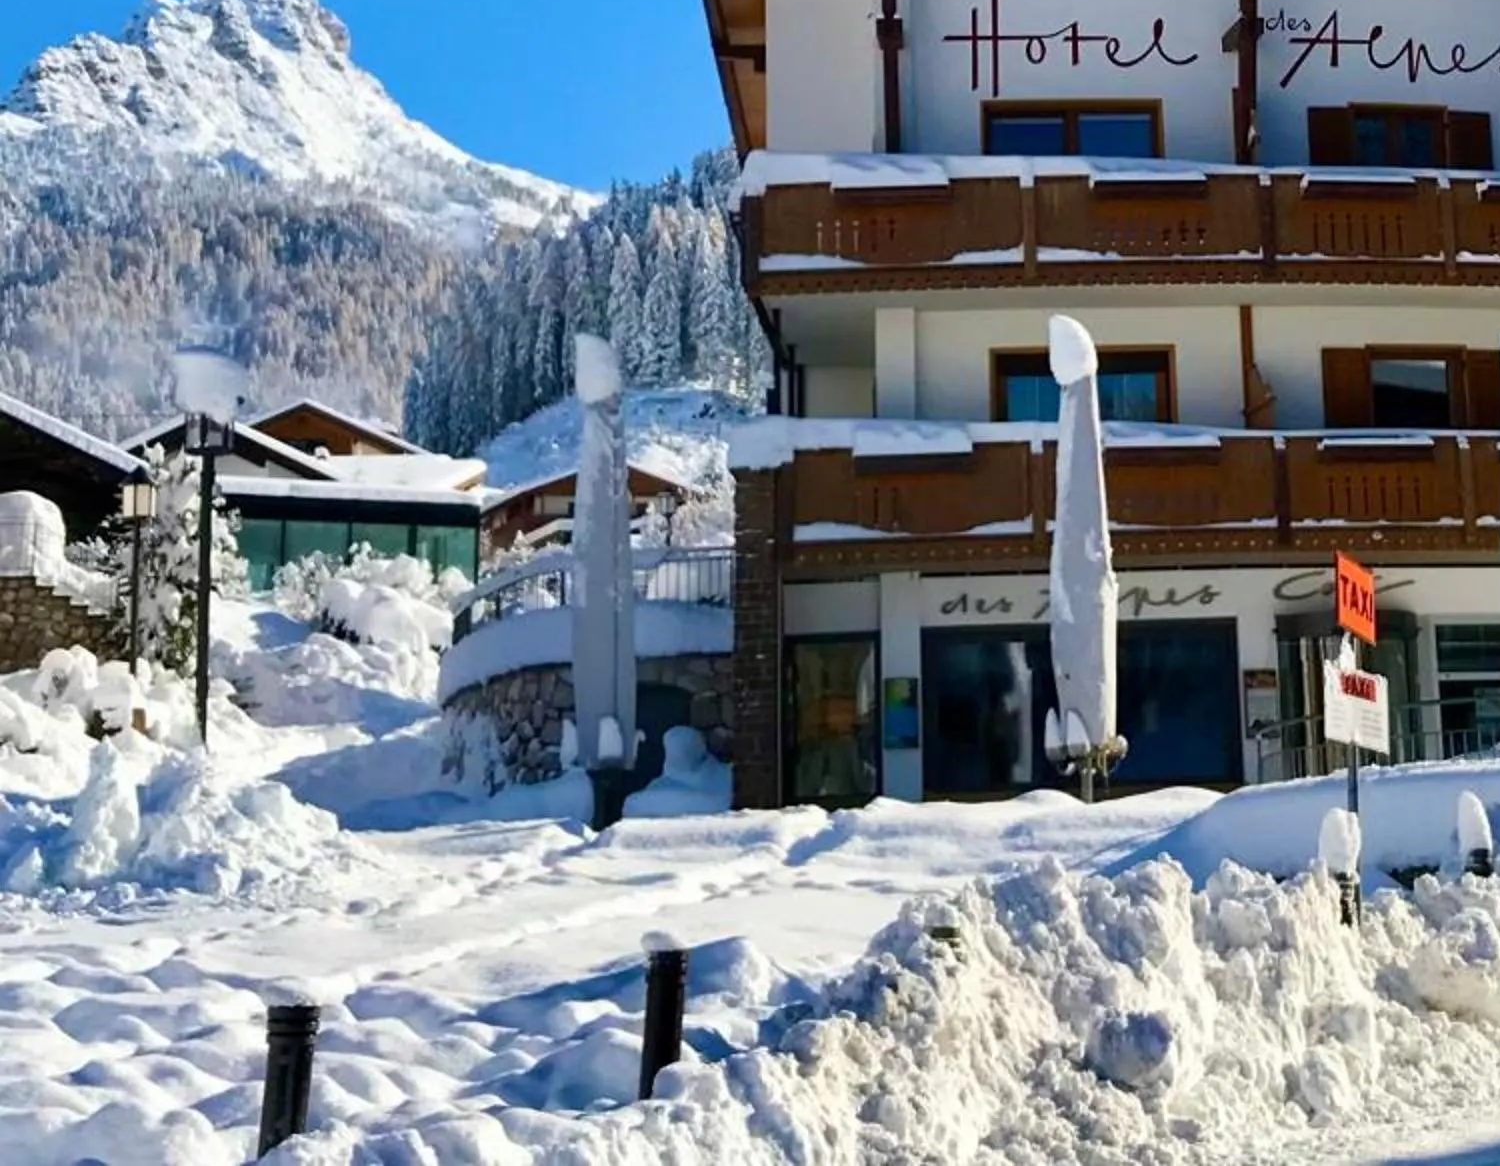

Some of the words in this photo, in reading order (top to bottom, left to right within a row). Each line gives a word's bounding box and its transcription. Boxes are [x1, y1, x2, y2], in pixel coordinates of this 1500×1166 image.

[1265, 9, 1312, 33] des
[940, 592, 1014, 615] des
[1339, 573, 1374, 623] TAXI
